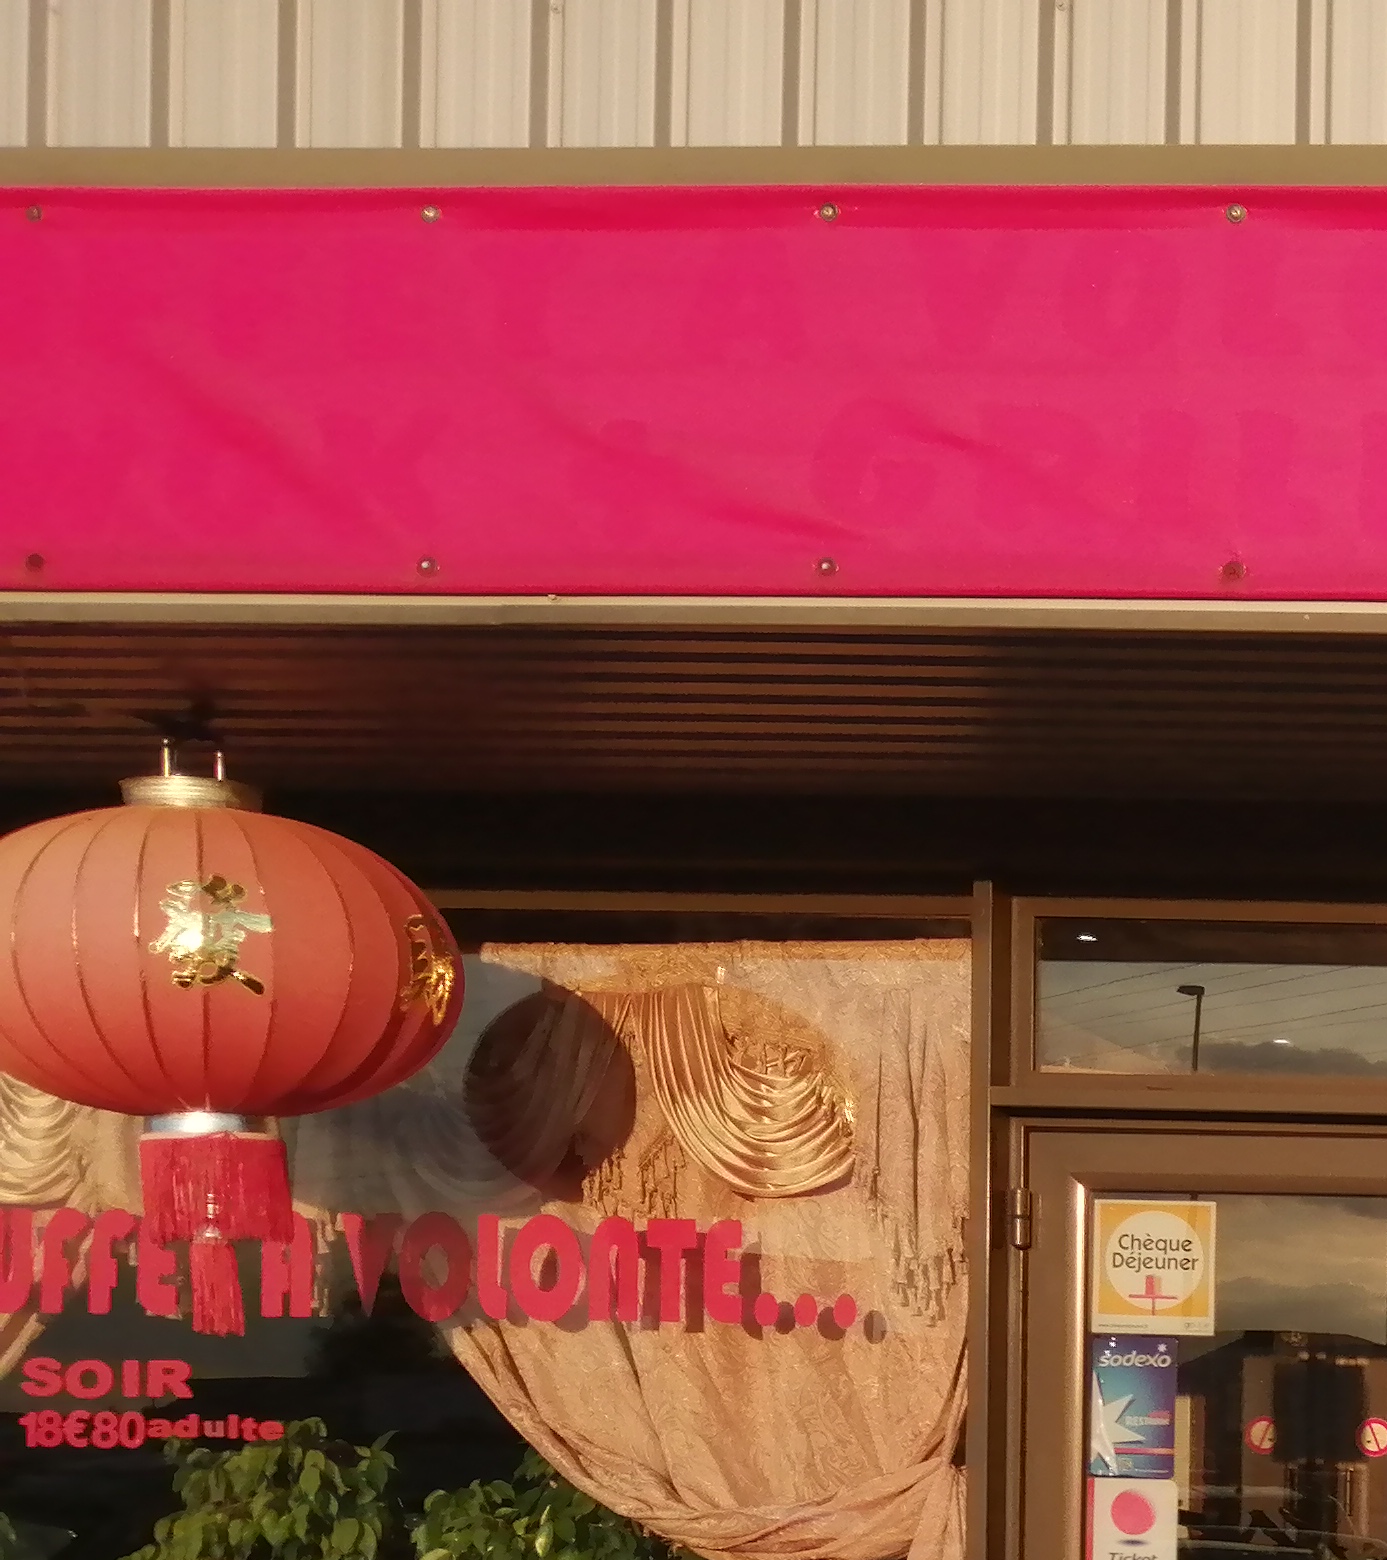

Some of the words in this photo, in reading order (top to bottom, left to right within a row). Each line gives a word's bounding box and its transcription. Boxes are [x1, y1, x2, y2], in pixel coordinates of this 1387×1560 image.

[1118, 1232, 1193, 1253] Chèque
[1112, 1252, 1199, 1273] Déjeuner
[1099, 1349, 1172, 1368] sodexo
[20, 1356, 194, 1399] SOIR
